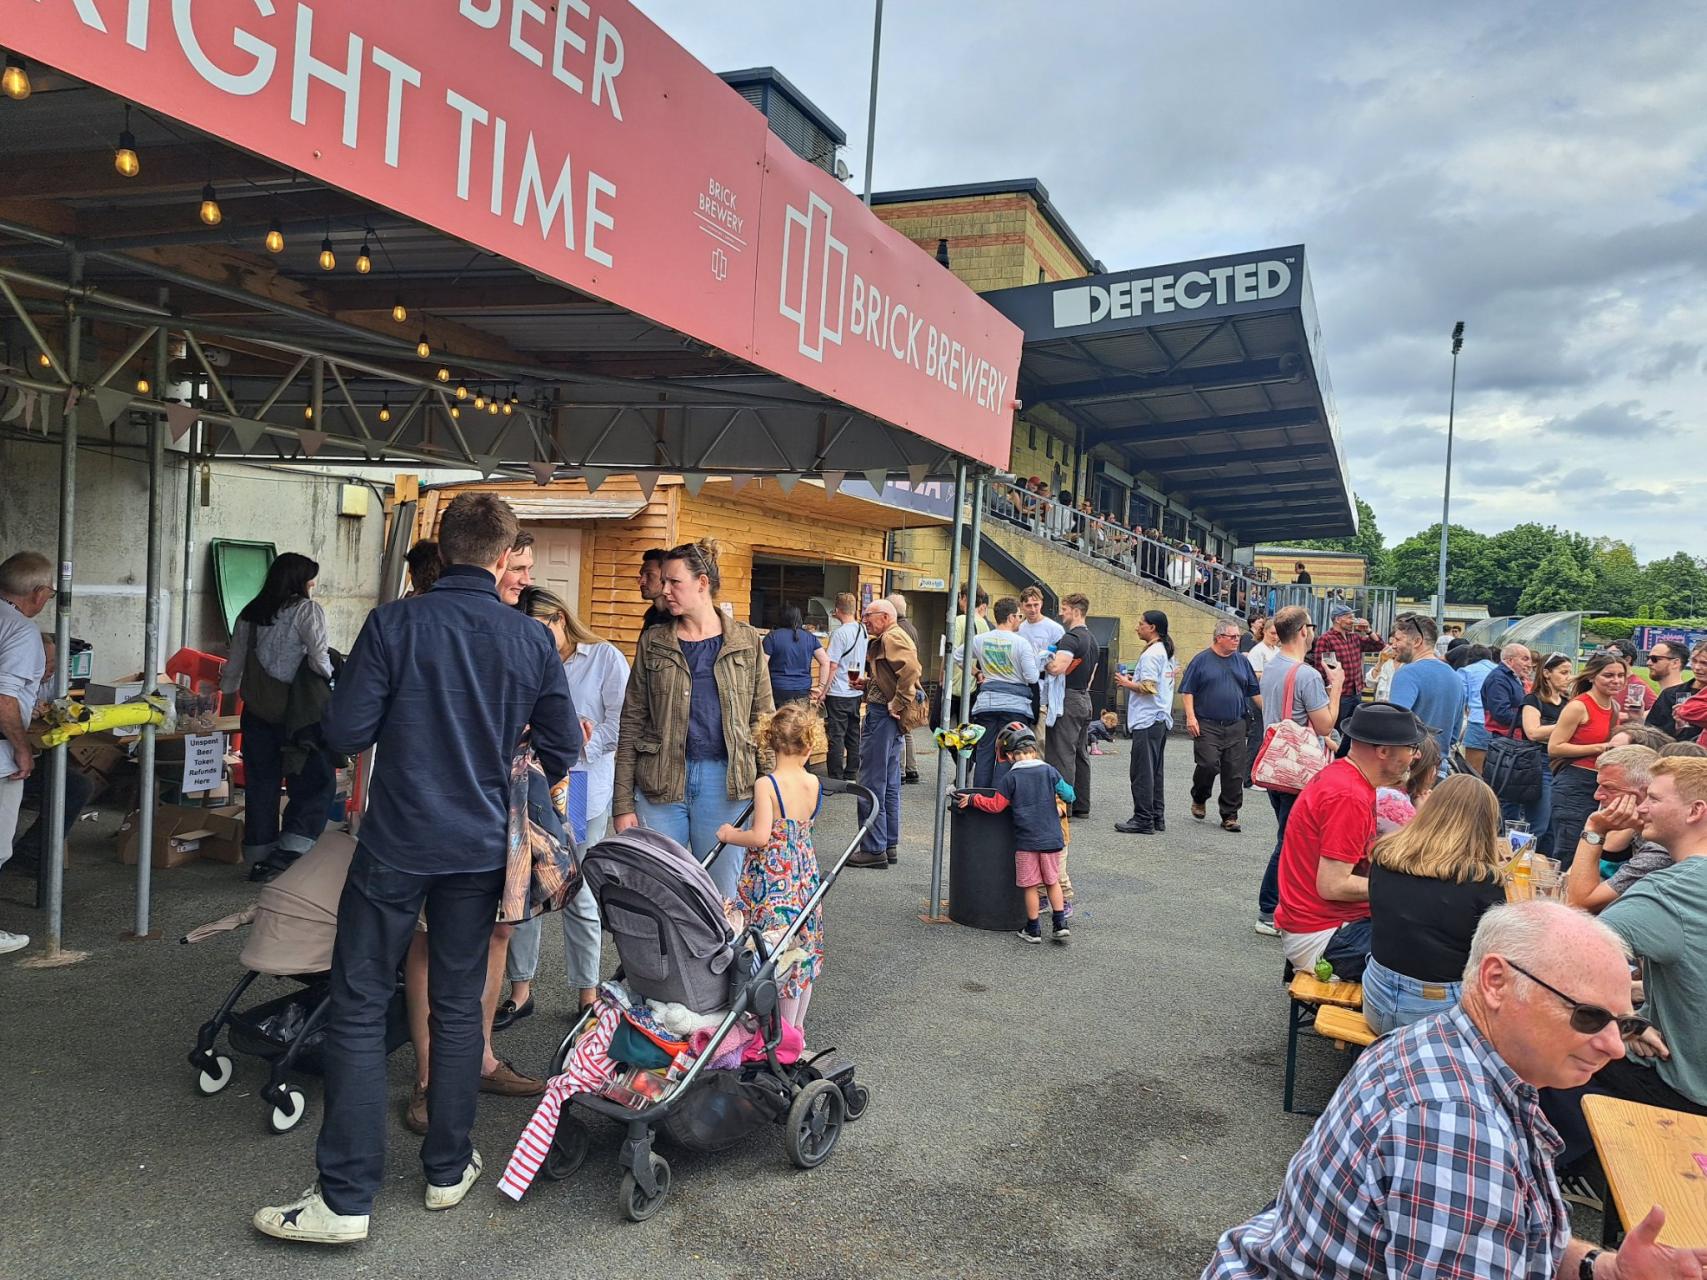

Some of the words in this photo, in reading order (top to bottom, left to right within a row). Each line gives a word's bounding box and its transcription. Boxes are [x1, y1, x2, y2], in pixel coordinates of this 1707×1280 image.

[33, 0, 422, 168] GHT
[446, 88, 617, 268] TIME
[698, 193, 744, 233] BREWERY
[708, 177, 737, 210] BRICK
[1053, 260, 1292, 328] DEFECTED
[850, 273, 925, 370] BRICK
[925, 325, 1008, 415] BREWERY
[190, 738, 219, 746] Unspent
